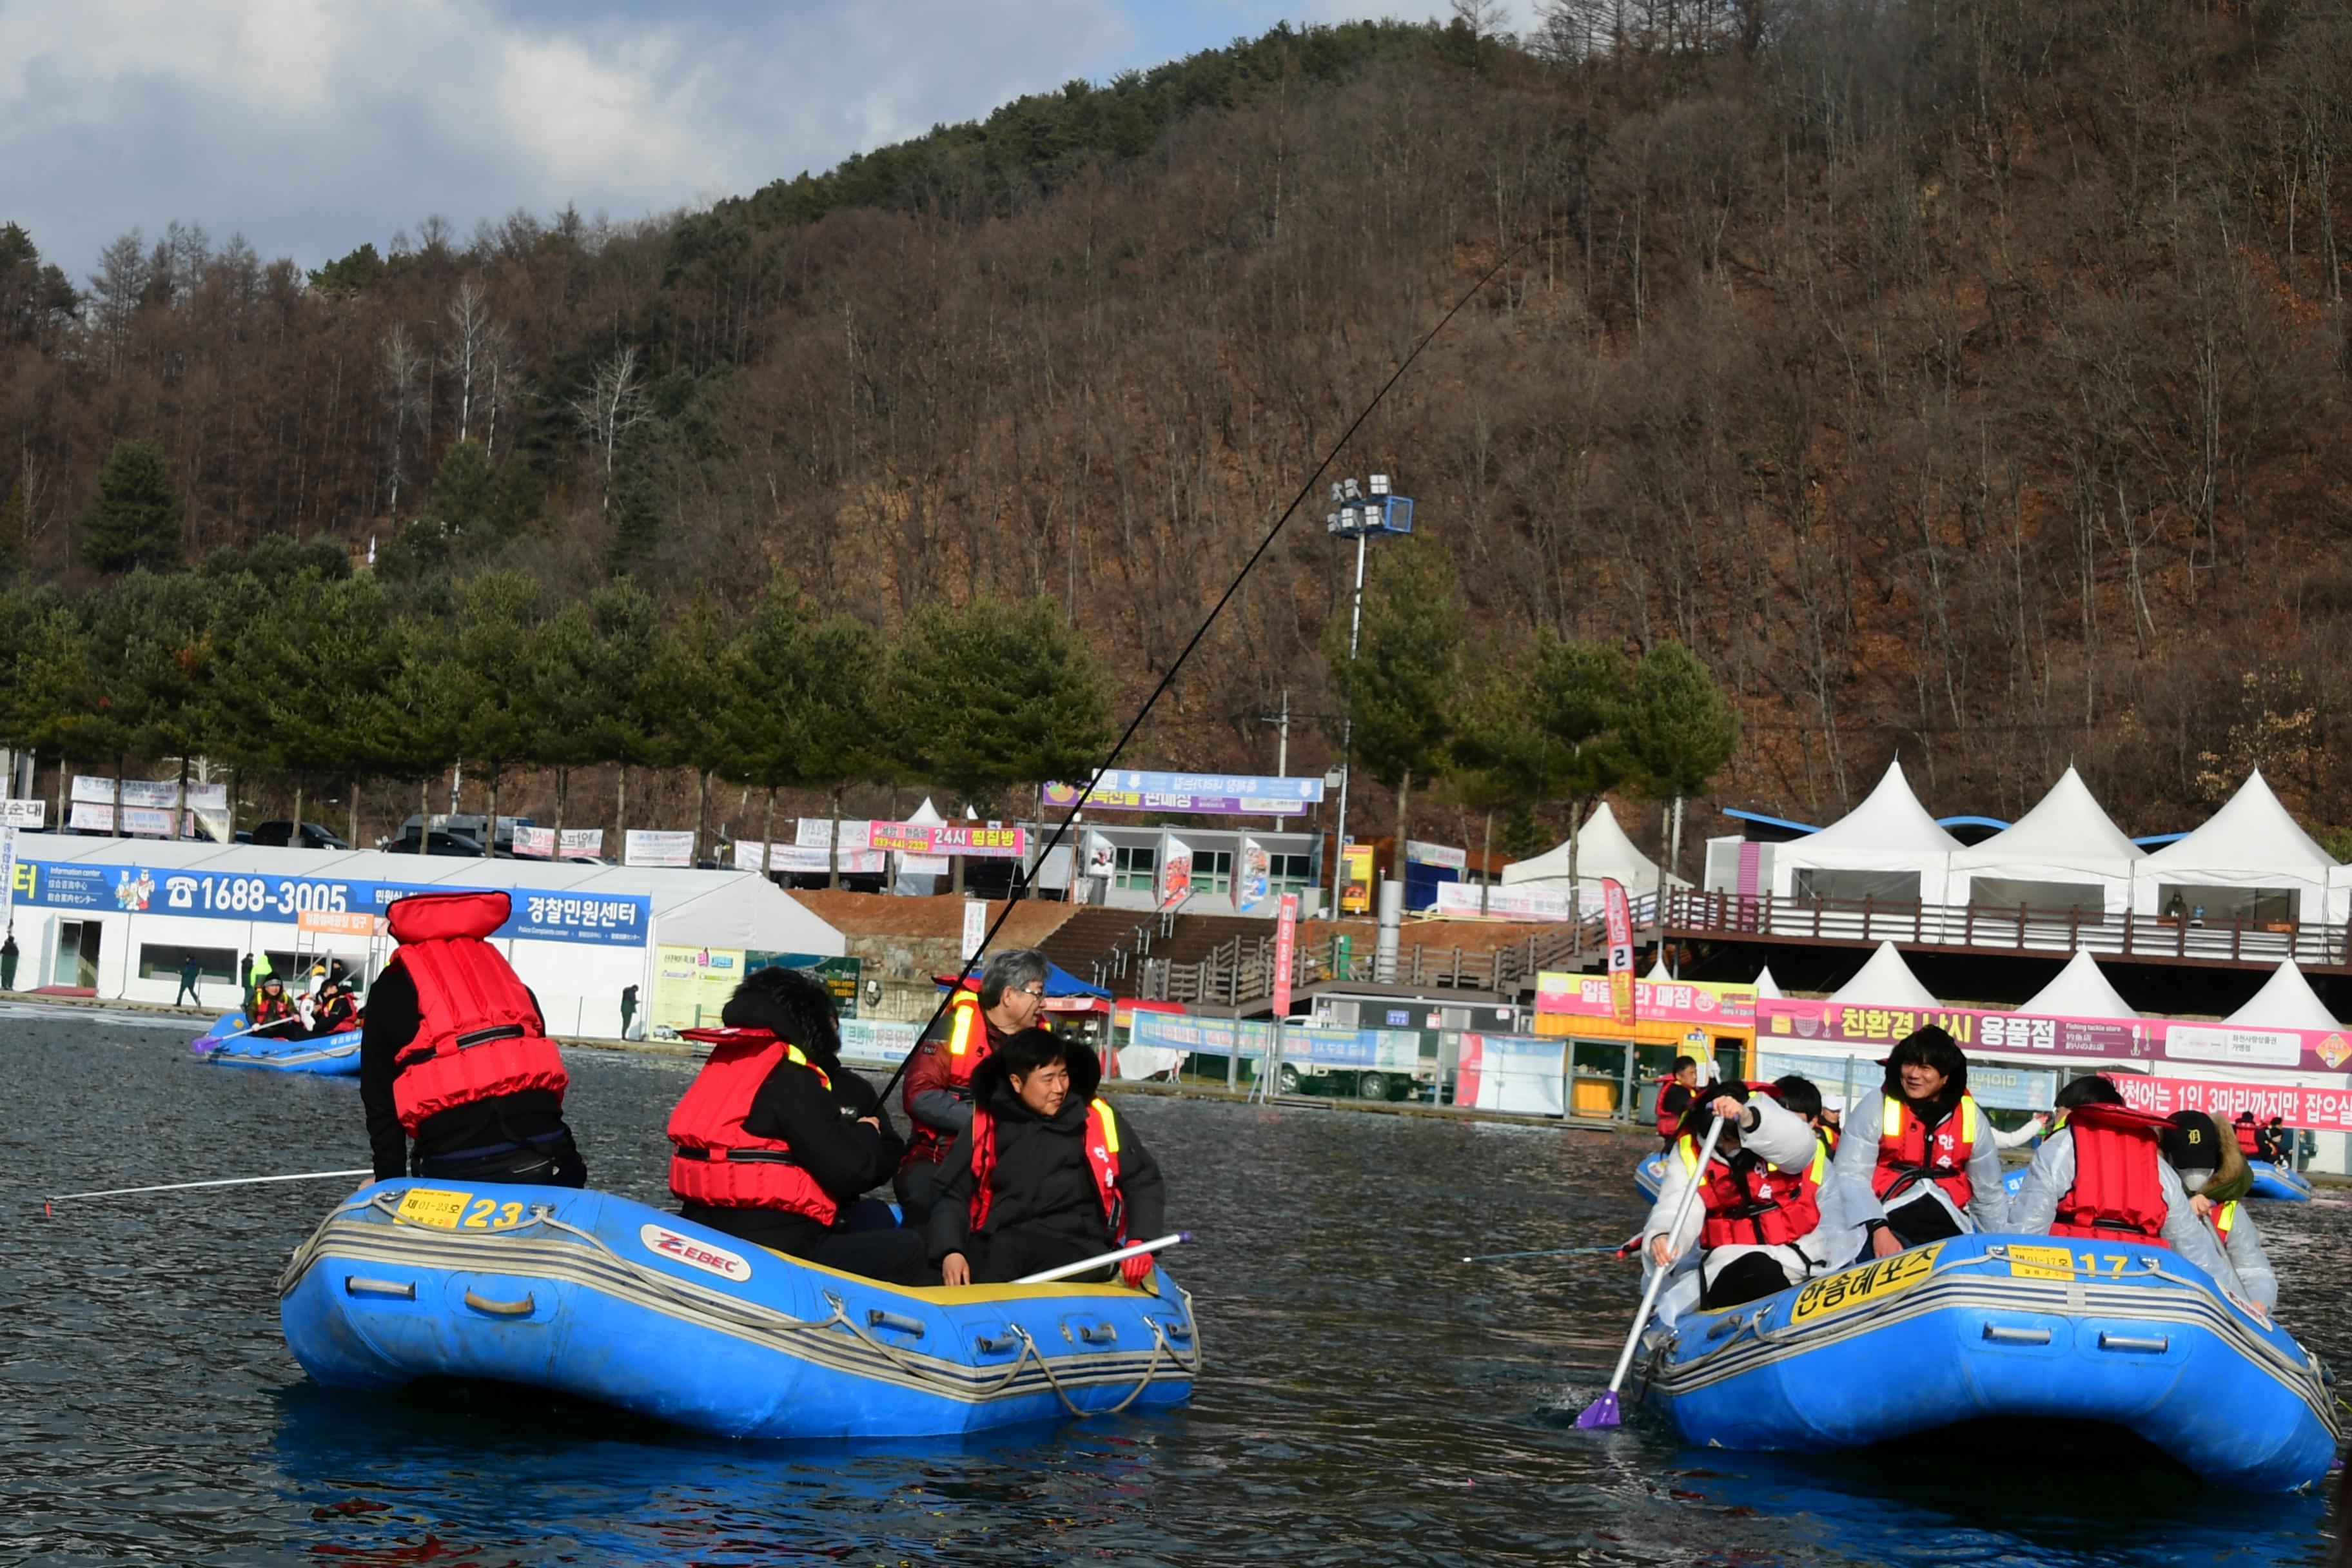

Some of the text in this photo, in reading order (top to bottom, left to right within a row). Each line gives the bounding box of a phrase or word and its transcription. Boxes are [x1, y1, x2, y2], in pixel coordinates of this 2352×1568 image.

[935, 829, 1014, 847] 24시 찜질방
[50, 866, 101, 877] Information center
[201, 877, 348, 914] 1688-3005
[527, 897, 636, 927] 경찰민원센터
[1656, 984, 1691, 1008] 매점
[1841, 1008, 1915, 1040] 친환경
[1981, 1016, 2055, 1049] 용품점
[2066, 1023, 2086, 1032] Fishing
[2178, 1084, 2202, 1110] 1인
[2208, 1088, 2298, 1121] 3마리까지만
[2188, 1129, 2201, 1145] D
[464, 1199, 524, 1228] 23
[654, 1231, 739, 1273] ZEBEC
[2079, 1253, 2128, 1279] 17
[1798, 1246, 1939, 1317] 한송레포츠
